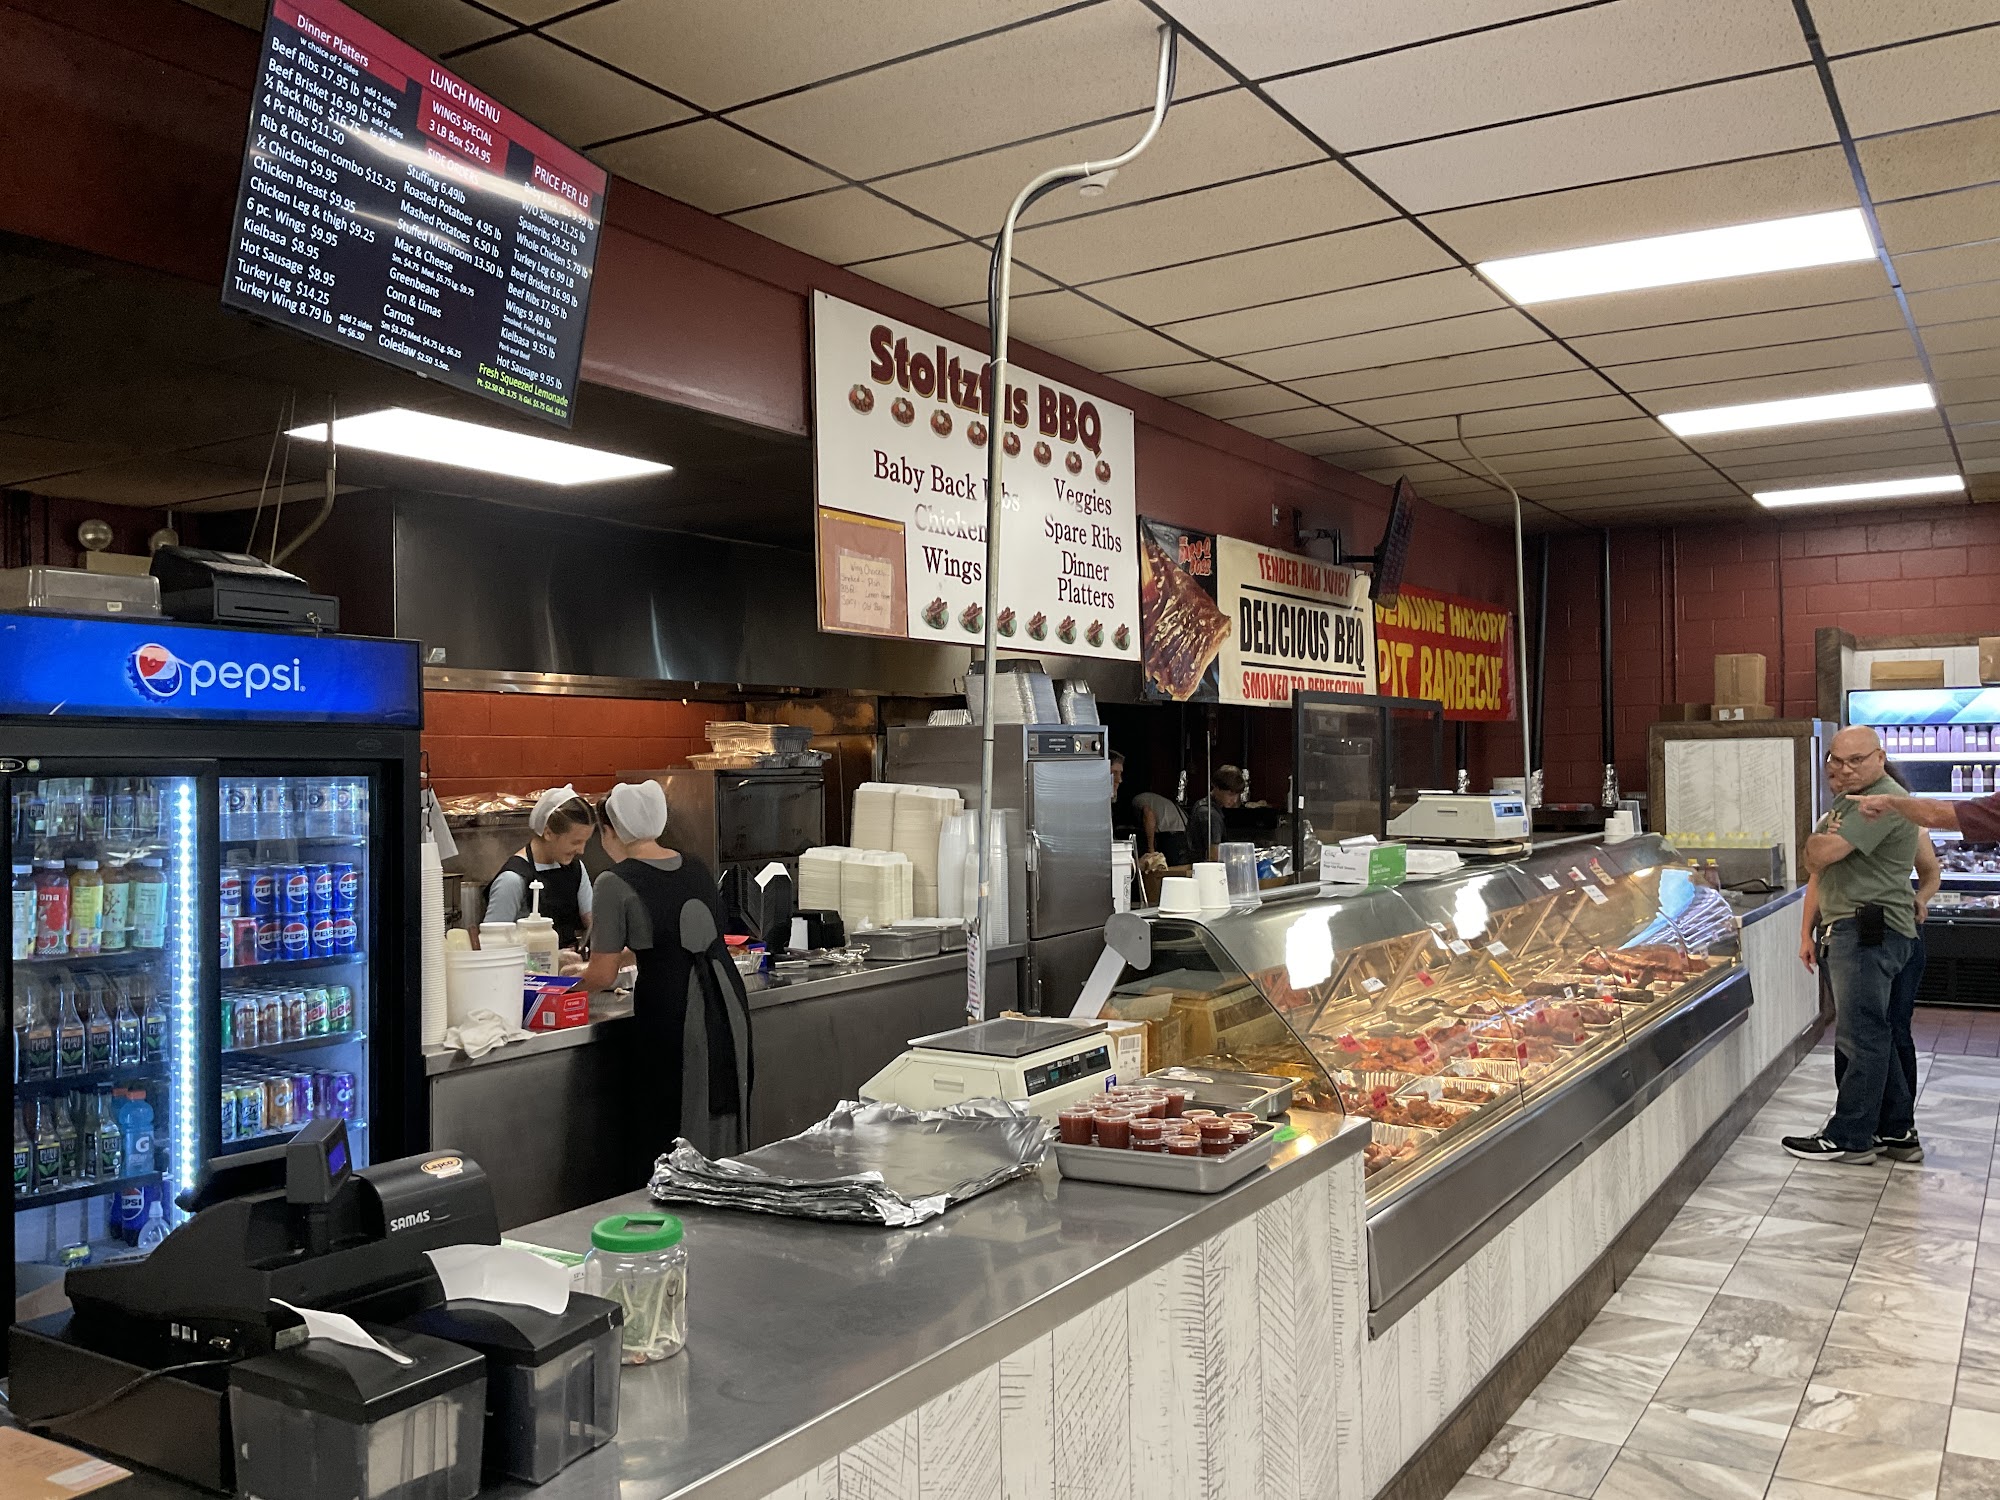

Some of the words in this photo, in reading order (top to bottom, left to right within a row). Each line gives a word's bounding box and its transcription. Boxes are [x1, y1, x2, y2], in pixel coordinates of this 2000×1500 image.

[296, 14, 331, 43] Dinner
[332, 35, 368, 67] Platters
[271, 36, 297, 60] Beef
[297, 51, 319, 73] Ribs
[320, 65, 348, 90] 17.95
[349, 80, 359, 96] lb
[268, 57, 294, 81] Beef
[294, 71, 328, 101] Brisket
[330, 91, 358, 118] 16.99
[358, 106, 368, 122] lb
[275, 79, 301, 103] Rack
[302, 93, 323, 115] Ribs
[327, 106, 360, 128] $16.75
[363, 85, 376, 97] add
[376, 91, 381, 100] 2
[381, 95, 397, 109] sides
[430, 68, 467, 103] LUNCH
[467, 93, 500, 123] MENU
[262, 93, 271, 107] 4
[272, 97, 285, 114] Pc
[286, 105, 309, 127] Ribs
[310, 116, 344, 145] $11.50
[428, 118, 435, 131] 3
[436, 123, 446, 137] LB
[447, 129, 463, 148] Box
[463, 138, 491, 163] $24.95
[432, 99, 461, 126] WINGS
[461, 118, 492, 146] SPECIAL
[259, 113, 278, 132] Rib
[279, 123, 288, 139] &
[290, 129, 329, 159] Chicken
[330, 152, 363, 176] combo
[364, 166, 396, 193] $15.25
[268, 140, 308, 170] Chicken
[309, 159, 338, 183] $9.95
[253, 155, 294, 184] Chicken
[295, 174, 328, 201] Breast
[328, 189, 356, 213] $9.95
[406, 165, 439, 192] Stuffing
[534, 164, 560, 190] PRICE
[560, 180, 577, 201] PER
[578, 191, 588, 207] LB
[246, 196, 255, 210] 6
[255, 203, 271, 218] pc.
[274, 207, 306, 233] Wings
[309, 223, 338, 246] $9.95
[250, 175, 290, 205] Chicken
[292, 194, 310, 216] Leg
[311, 203, 320, 218] &
[322, 209, 347, 231] thigh
[348, 220, 375, 243] $9.25
[399, 198, 435, 225] Mashed
[435, 216, 470, 243] Potatoes
[472, 236, 490, 253] 6.50
[490, 244, 499, 258] lb
[243, 216, 286, 246] Kielbasa
[290, 236, 319, 259] $8.95
[393, 235, 414, 254] Mac
[414, 245, 422, 259] &
[423, 250, 453, 273] Cheese
[516, 231, 539, 252] Whole
[539, 244, 565, 266] Chicken
[565, 258, 581, 274] 5.79
[581, 266, 588, 279] lb
[517, 215, 550, 241] Spareribs
[550, 232, 570, 251] $9.25
[570, 243, 577, 256] lb
[237, 257, 272, 285] Turkey
[273, 272, 292, 293] Leg
[295, 280, 329, 305] $14.25
[239, 237, 261, 256] Hot
[261, 246, 303, 274] Sausage
[307, 264, 335, 286] $8.95
[389, 266, 439, 298] Greenbeans
[234, 275, 269, 302] Turkey
[271, 289, 298, 313] Wing
[298, 301, 321, 319] 8.79
[322, 309, 332, 324] lb
[383, 303, 414, 326] Carrots
[386, 285, 407, 303] Corn
[408, 294, 416, 308] &
[417, 297, 441, 318] Limas
[337, 323, 347, 334] for
[346, 327, 365, 341] $6.50
[338, 313, 352, 322] add
[351, 316, 357, 325] 2
[356, 319, 372, 331] sides
[378, 333, 416, 357] Coleslaw
[478, 362, 499, 380] Fresh
[499, 370, 533, 394] Squeezed
[534, 384, 568, 407] Lemonade
[1038, 383, 1102, 459] BBQ
[873, 449, 925, 494] Baby
[930, 464, 978, 500] Back
[982, 478, 1020, 513] bs
[1053, 478, 1112, 515] Veggies
[914, 503, 988, 543] Chicken
[1044, 515, 1087, 544] Spare
[1091, 524, 1122, 553] Ribs
[921, 545, 982, 585] Wings
[1061, 550, 1110, 582] Dinner
[1257, 552, 1299, 587] TENDER
[1300, 562, 1321, 592] AND
[1323, 568, 1350, 597] JUICY
[1057, 577, 1115, 609] Platters
[1239, 596, 1329, 663] DELICIOUS
[1334, 614, 1365, 672] BBQ
[1448, 603, 1507, 644] HICKORY
[190, 658, 300, 698] pepsi
[1242, 670, 1289, 701] SMOKED
[1377, 638, 1414, 698] PIT
[1419, 645, 1503, 711] BARBECUE
[135, 1136, 150, 1153] G
[390, 1209, 431, 1232] SAM4S
